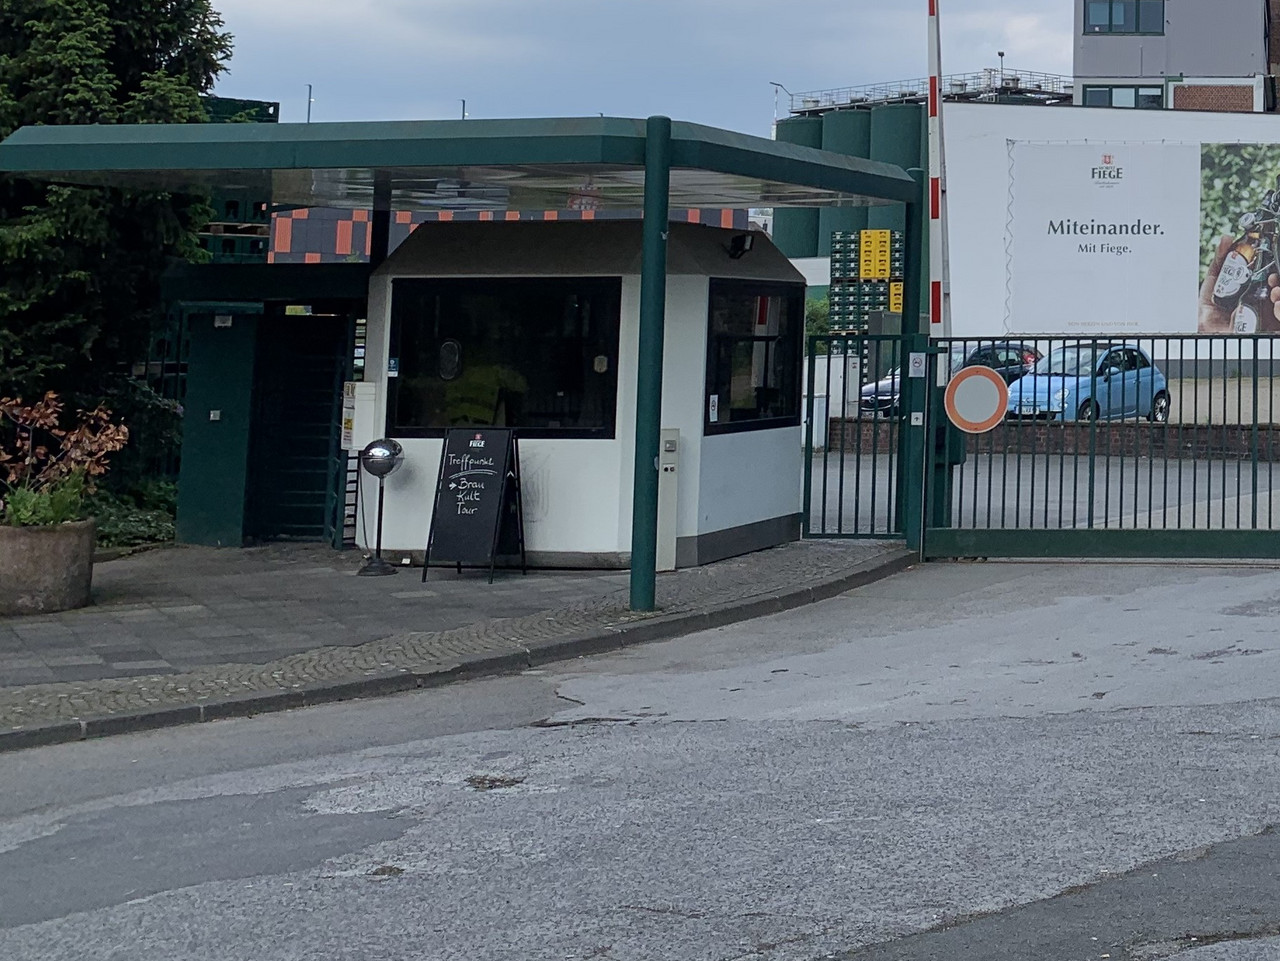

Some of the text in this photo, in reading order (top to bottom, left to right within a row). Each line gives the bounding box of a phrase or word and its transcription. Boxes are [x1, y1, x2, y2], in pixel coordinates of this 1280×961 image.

[1091, 167, 1123, 179] FIEGE
[1047, 219, 1165, 235] Miteinander.
[1078, 243, 1132, 256] Mit Fiege.
[448, 453, 495, 471] Treffpunkt
[457, 477, 485, 490] Brau
[456, 490, 480, 502] Kult
[456, 502, 478, 515] Tour
